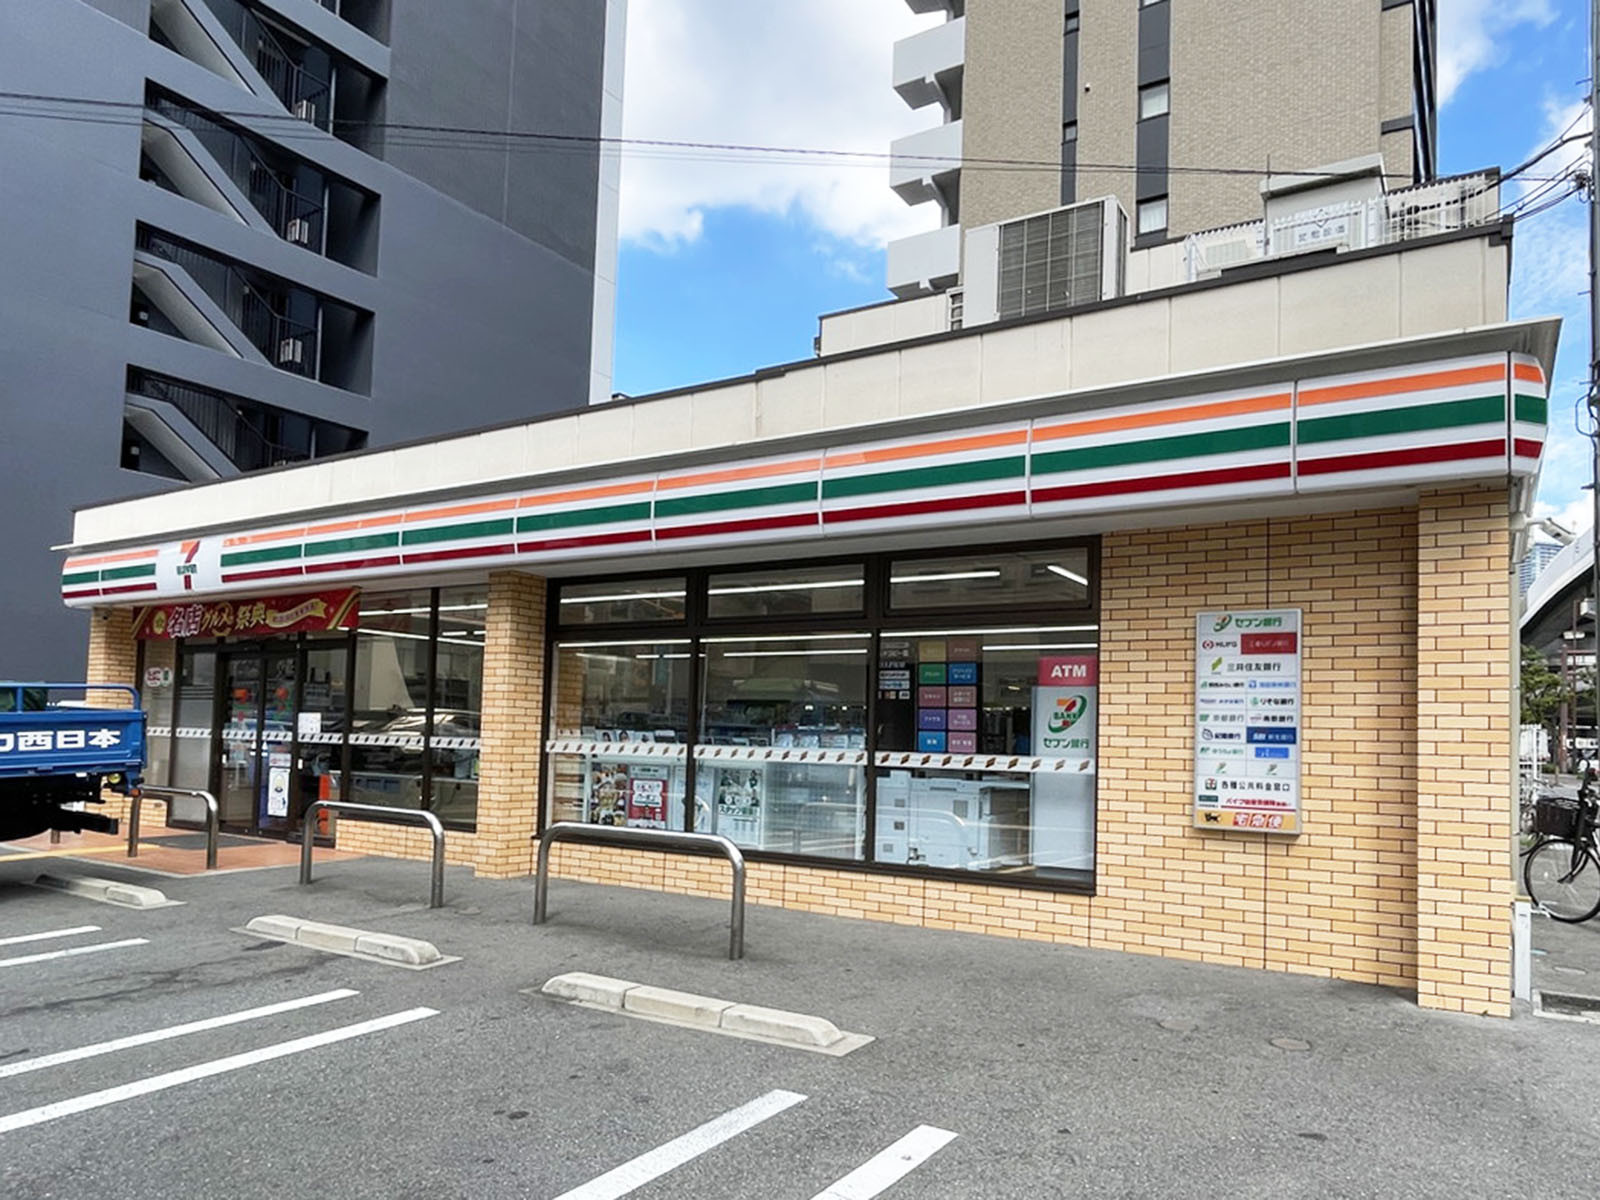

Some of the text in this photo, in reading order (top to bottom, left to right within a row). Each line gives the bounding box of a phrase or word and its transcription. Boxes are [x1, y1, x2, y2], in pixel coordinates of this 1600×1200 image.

[1234, 616, 1283, 628] セブン銀行
[1051, 665, 1087, 678] ATM
[1228, 662, 1282, 672] 三井住友銀行
[1043, 738, 1089, 749] セブン銀行
[1221, 780, 1291, 792] 各種公共料金窓口
[1236, 813, 1283, 829] 宅急便
